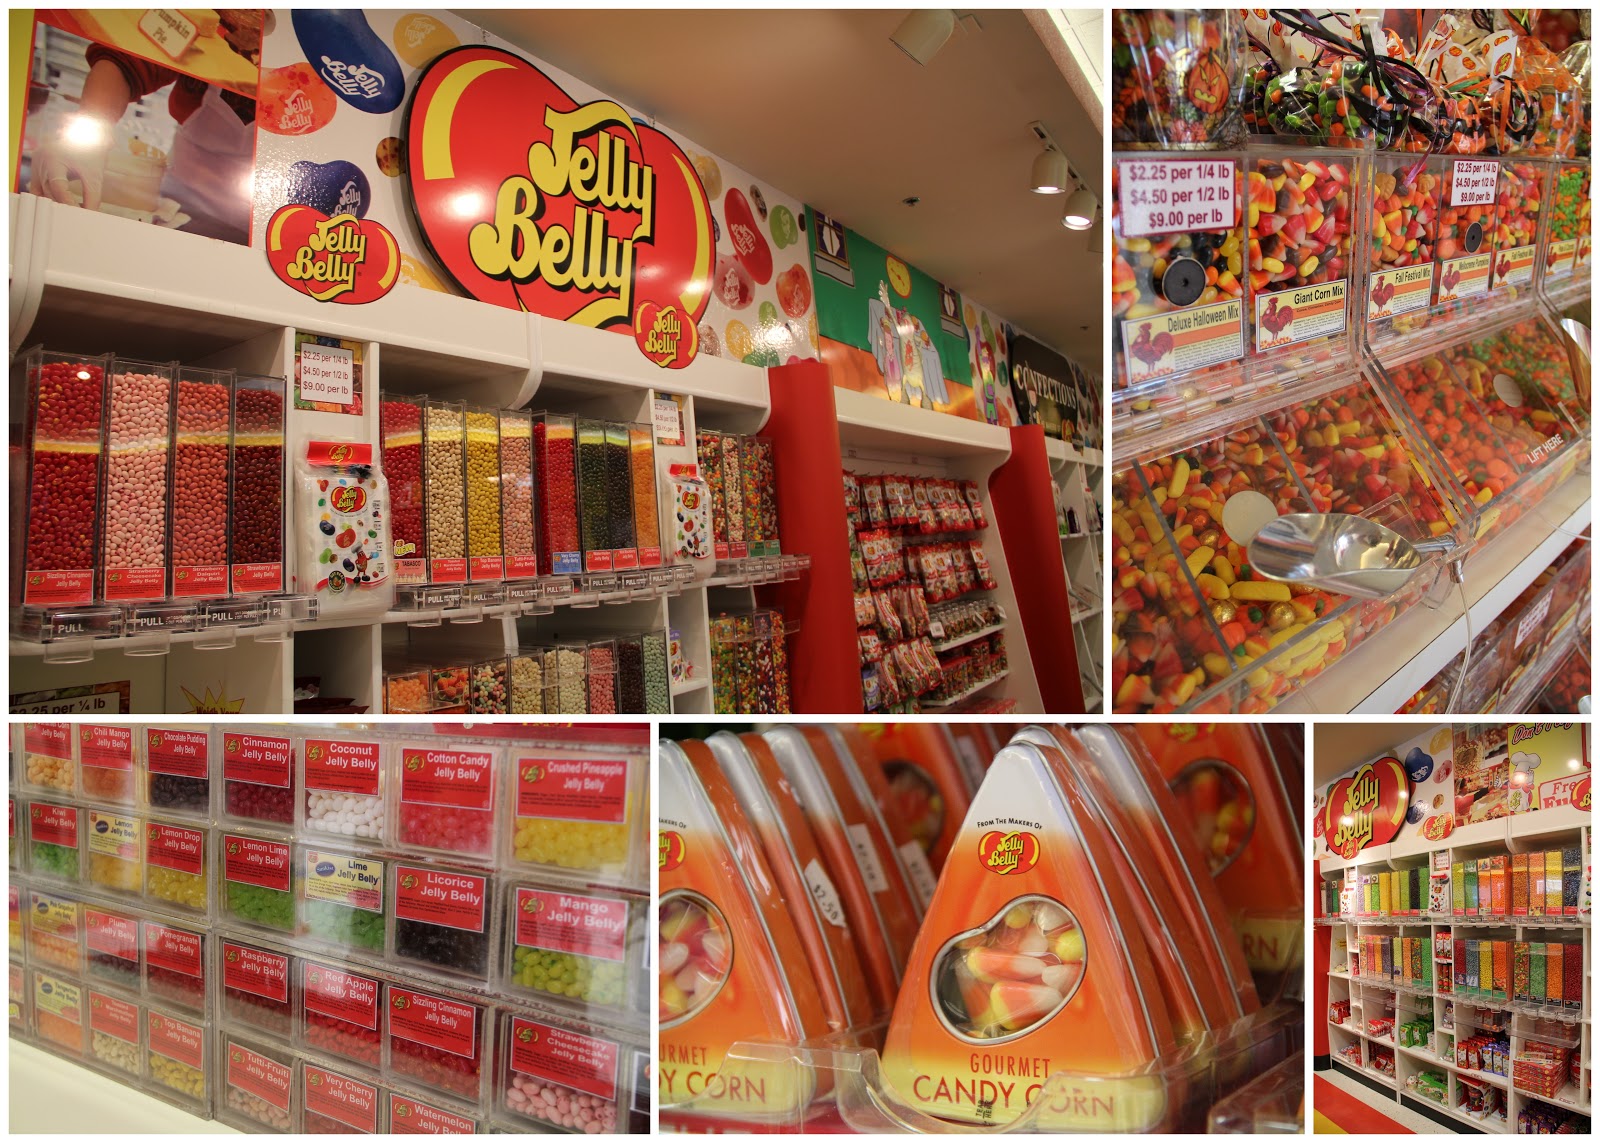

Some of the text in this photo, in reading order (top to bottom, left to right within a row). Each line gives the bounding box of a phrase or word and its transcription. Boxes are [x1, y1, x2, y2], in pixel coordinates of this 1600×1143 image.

[153, 27, 167, 43] Pie
[321, 56, 361, 95] Belly
[348, 64, 385, 98] Jelly
[284, 90, 313, 118] Jelly
[279, 111, 313, 134] Belly
[528, 100, 656, 246] Jelly
[1129, 165, 1230, 183] $2.25 per 1/4 lb
[1457, 164, 1472, 172] $2.25
[1472, 165, 1482, 175] per
[1491, 164, 1497, 173] lb
[339, 180, 361, 205] Jelly
[1455, 179, 1470, 187] $4.50
[1471, 179, 1480, 189] per
[1489, 178, 1495, 187] lb
[1130, 188, 1230, 206] $4.50 per 1/2 lb
[1460, 192, 1490, 203] $9.00 per lb
[1149, 209, 1223, 228] $9.00 per lb
[308, 214, 366, 264] Jelly
[731, 224, 747, 256] Belly
[740, 224, 755, 253] Jelly
[469, 176, 637, 327] Belly
[286, 246, 355, 301] Belly
[1395, 273, 1404, 283] Fall
[1404, 270, 1422, 282] Festival
[1294, 286, 1343, 305] Giant Corn Mix
[654, 306, 681, 340] Jelly
[1167, 305, 1239, 333] Deluxe Halloween Mix
[645, 330, 677, 367] Belly
[303, 351, 348, 365] $2.25 per 1/4 lb
[303, 366, 348, 380] $4.50 per 1/2 lb
[303, 381, 348, 396] $9.00 per lb
[1016, 364, 1076, 409] CONFECTIONS
[1527, 434, 1564, 464] LIFT HERE
[342, 486, 357, 499] Jelly
[337, 498, 354, 512] Belly
[46, 571, 91, 580] Sizzling Cinnamon
[140, 617, 164, 626] PULL
[212, 612, 233, 621] PULL
[58, 624, 84, 633] PULL
[94, 728, 130, 738] Chili Mango
[163, 732, 206, 745] Chocolate Pudding
[242, 737, 288, 751] Cinnamon
[330, 743, 373, 756] Coconut
[242, 748, 287, 764] Jelly Belly
[325, 756, 377, 771] Jelly Belly
[427, 752, 489, 768] Cotton Candy
[434, 767, 480, 782] Jelly Belly
[547, 761, 623, 776] Crushed Pineapple
[563, 777, 605, 792] Jelly Belly
[1343, 764, 1379, 815] Jelly
[52, 808, 65, 817] Kiwi
[1433, 813, 1446, 828] Jelly
[114, 819, 133, 829] Lemon
[1334, 811, 1372, 849] Belly
[161, 827, 200, 842] Lemon Drop
[997, 831, 1024, 854] Jelly
[1428, 826, 1445, 841] Belly
[242, 840, 288, 856] Lemon Lime
[246, 852, 284, 868] Jelly Belly
[348, 860, 368, 871] Lime
[988, 850, 1018, 875] Belly
[337, 870, 379, 885] Jelly Belly
[426, 872, 474, 889] Licorice
[420, 886, 480, 906] Jelly Belly
[559, 897, 608, 914] Mango
[108, 918, 127, 928] Plum
[547, 911, 621, 932] Jelly Belly
[160, 929, 198, 945] Pomegranate
[241, 949, 285, 968] Raspberry
[241, 961, 284, 981] Jelly Belly
[325, 971, 374, 992] Red Apple
[325, 984, 373, 1006] Jelly Belly
[412, 996, 471, 1018] Sizzling Cinnamon
[164, 1019, 200, 1039] Top Banana
[546, 1037, 611, 1061] Cheesecake
[550, 1029, 607, 1052] Strawberry
[969, 1053, 1051, 1078] GOURMET
[325, 1074, 373, 1099] Very Cherry
[686, 1071, 767, 1104] CORN
[913, 1075, 1114, 1117] CANDY CORN
[414, 1104, 472, 1131] Watermelon
[976, 1098, 993, 1119] TEAR HERE
[417, 1119, 440, 1134] Jelly
